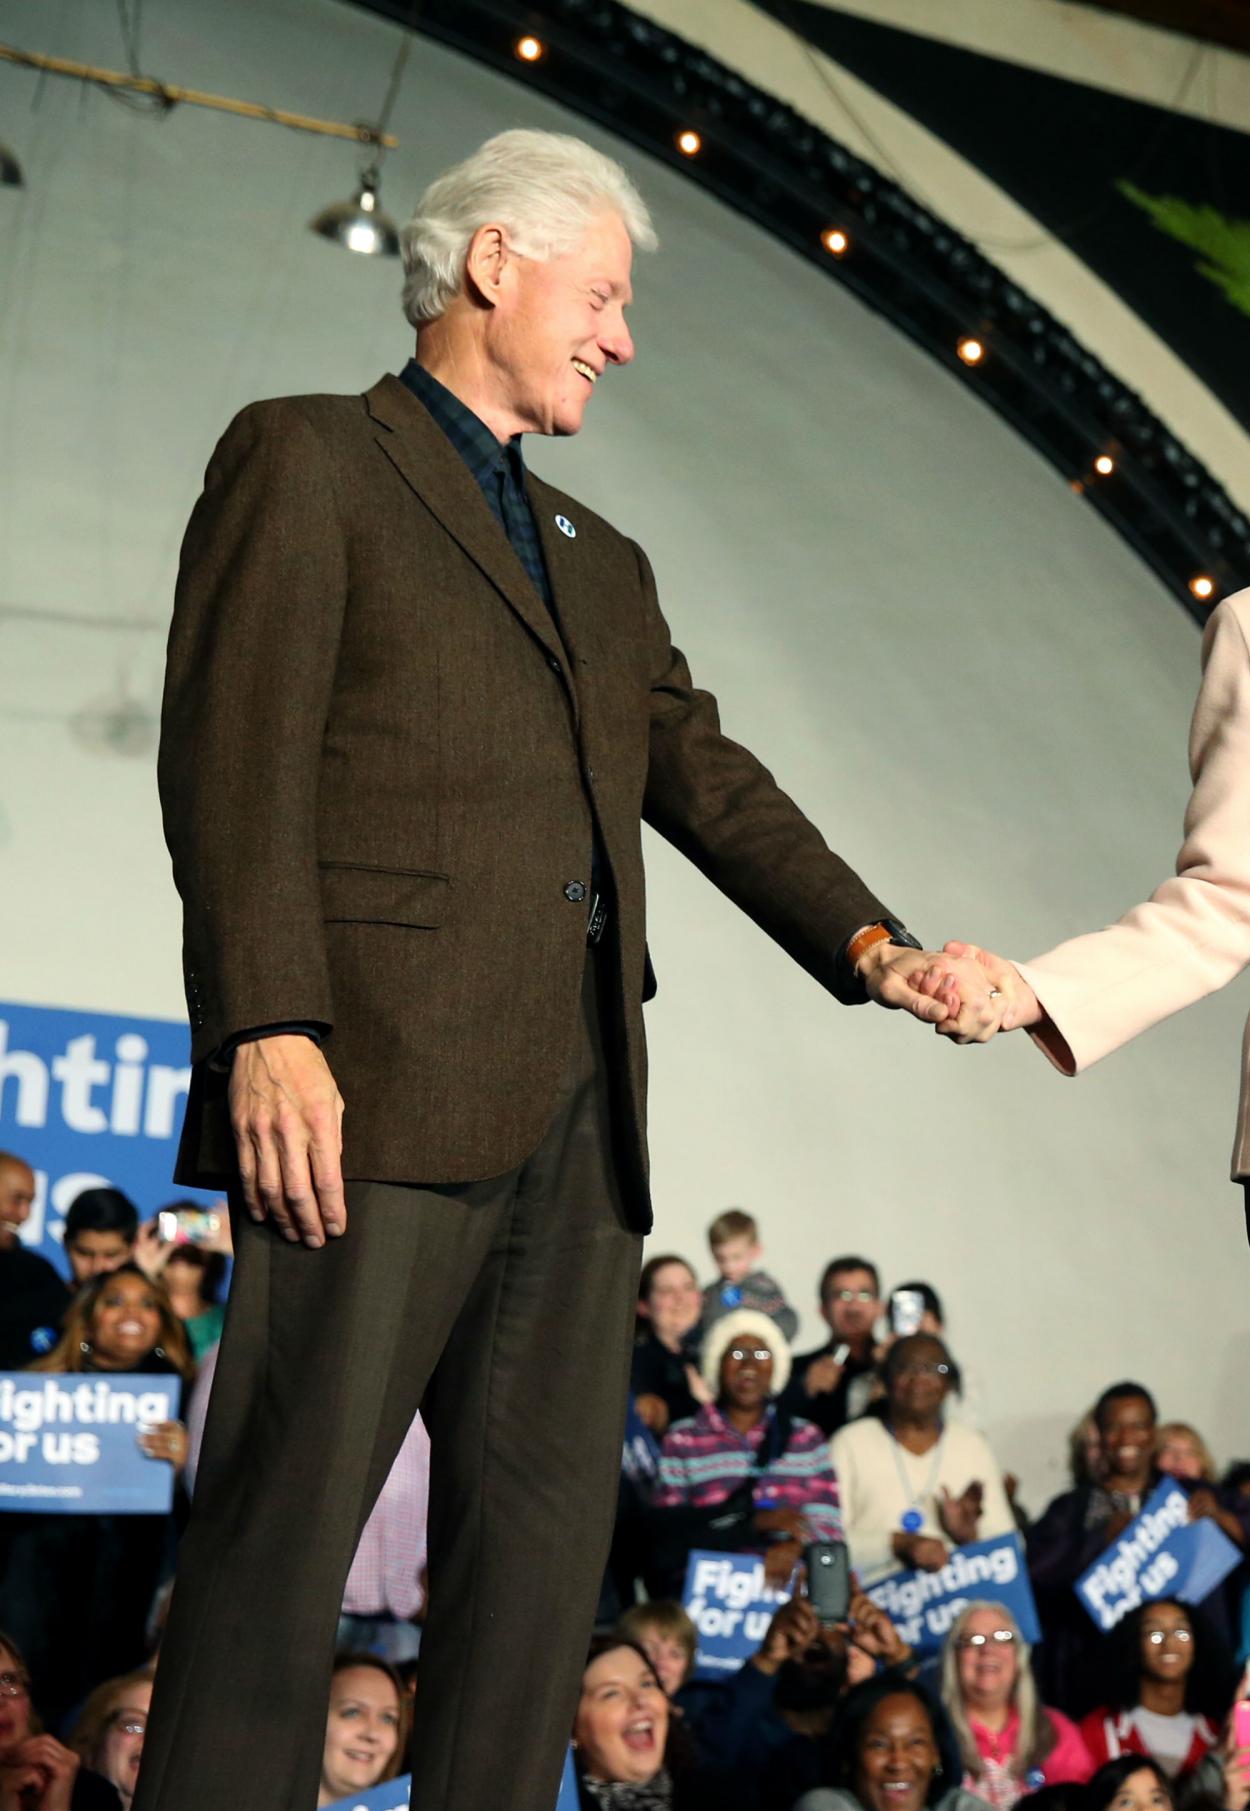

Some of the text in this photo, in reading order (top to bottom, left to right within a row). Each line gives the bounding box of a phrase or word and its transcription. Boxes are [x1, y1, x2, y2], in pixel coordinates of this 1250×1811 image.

[42, 1432, 100, 1465] us
[1083, 1491, 1190, 1606] Fighting
[1140, 1551, 1179, 1596] us
[868, 1547, 1018, 1618] Fighting
